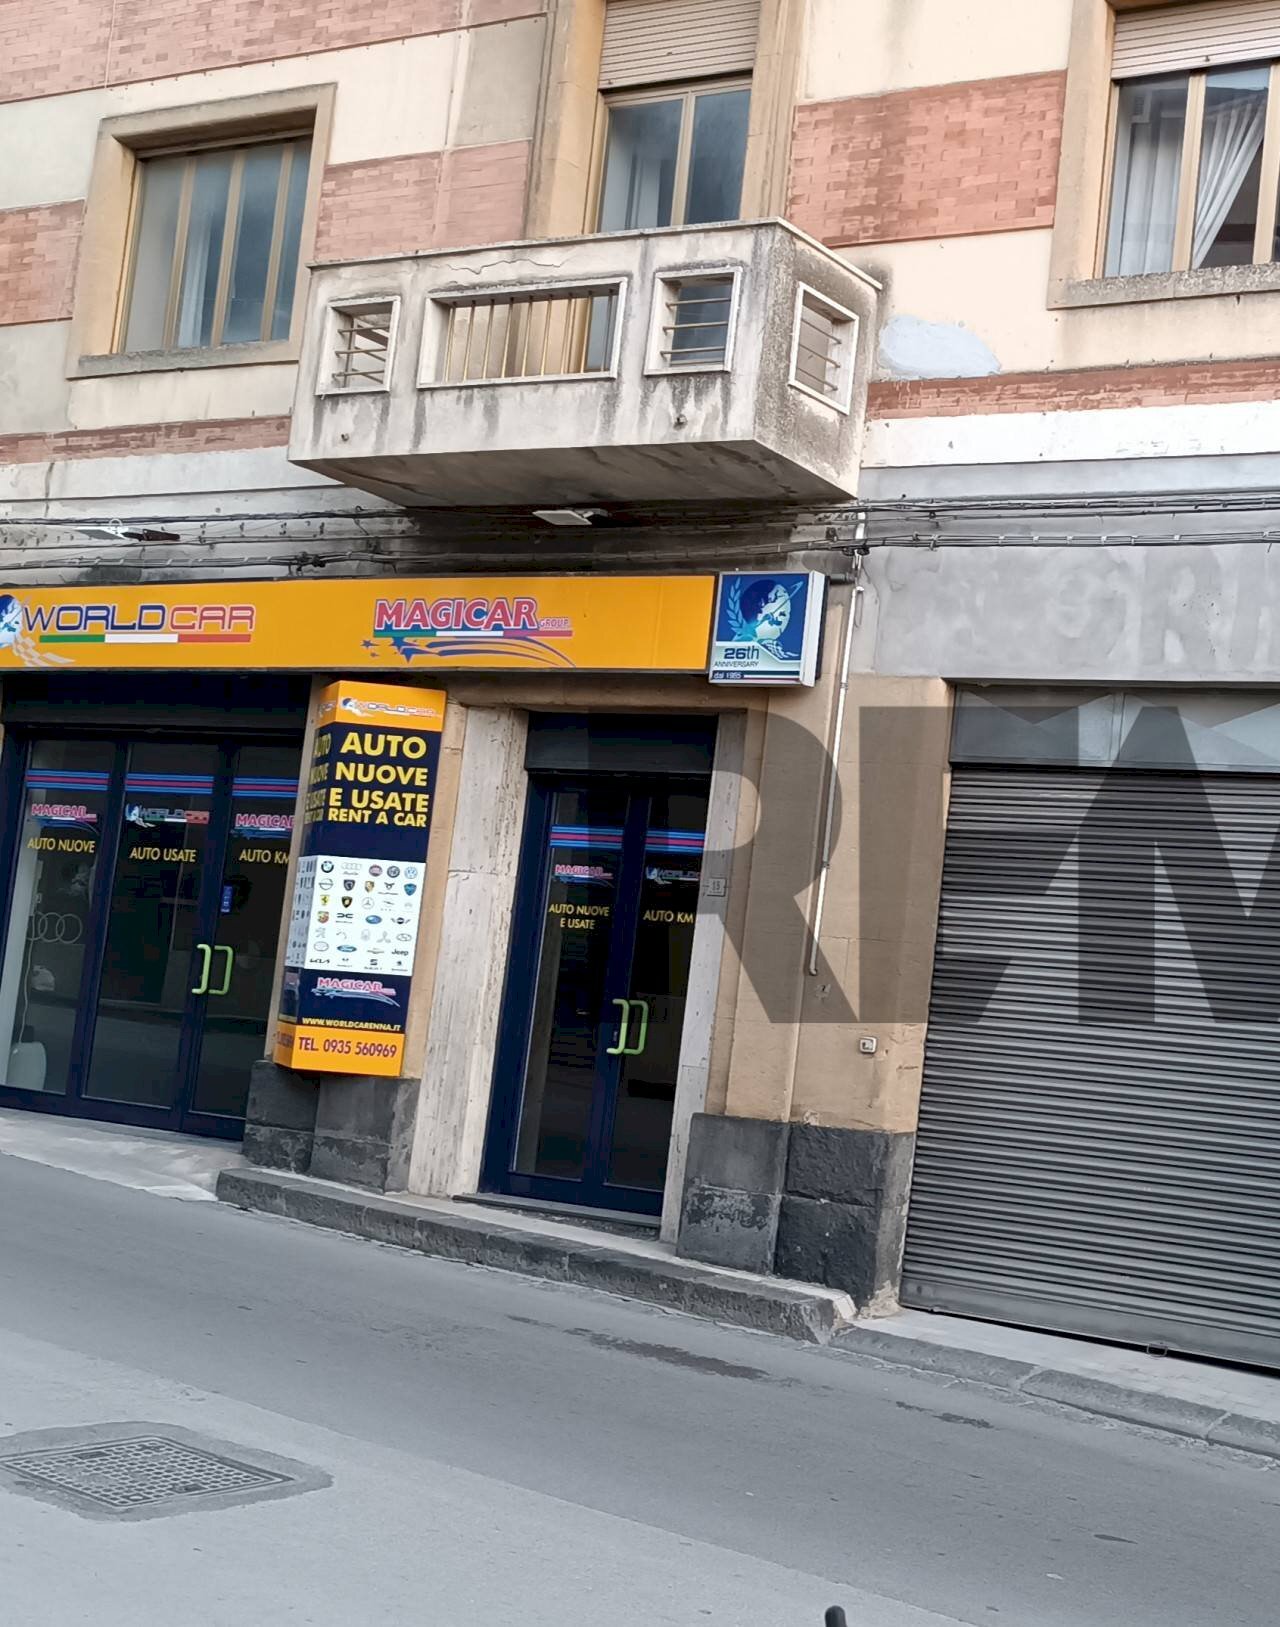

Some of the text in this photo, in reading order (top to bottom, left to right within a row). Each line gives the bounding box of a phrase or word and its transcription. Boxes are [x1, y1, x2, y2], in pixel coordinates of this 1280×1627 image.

[373, 597, 538, 630] MAGICAR
[724, 645, 760, 660] 26th
[339, 731, 427, 760] AUTO
[335, 761, 429, 787] NUOVE
[328, 787, 343, 807] E
[351, 789, 430, 813] USATE
[31, 803, 87, 818] MAGICAR
[327, 808, 372, 824] RENT
[375, 810, 389, 825] A
[393, 812, 427, 828] CAR
[27, 837, 96, 854] AUTO NUOVE
[130, 847, 197, 863] AUTO USATE
[238, 849, 272, 863] AUTO
[548, 903, 610, 917] AUTO NUOVE
[643, 909, 694, 924] AUTO KM
[559, 917, 595, 930] E USATE
[317, 976, 383, 993] MAGICAR
[323, 1039, 352, 1055] 0935
[355, 1041, 398, 1058] 560969
